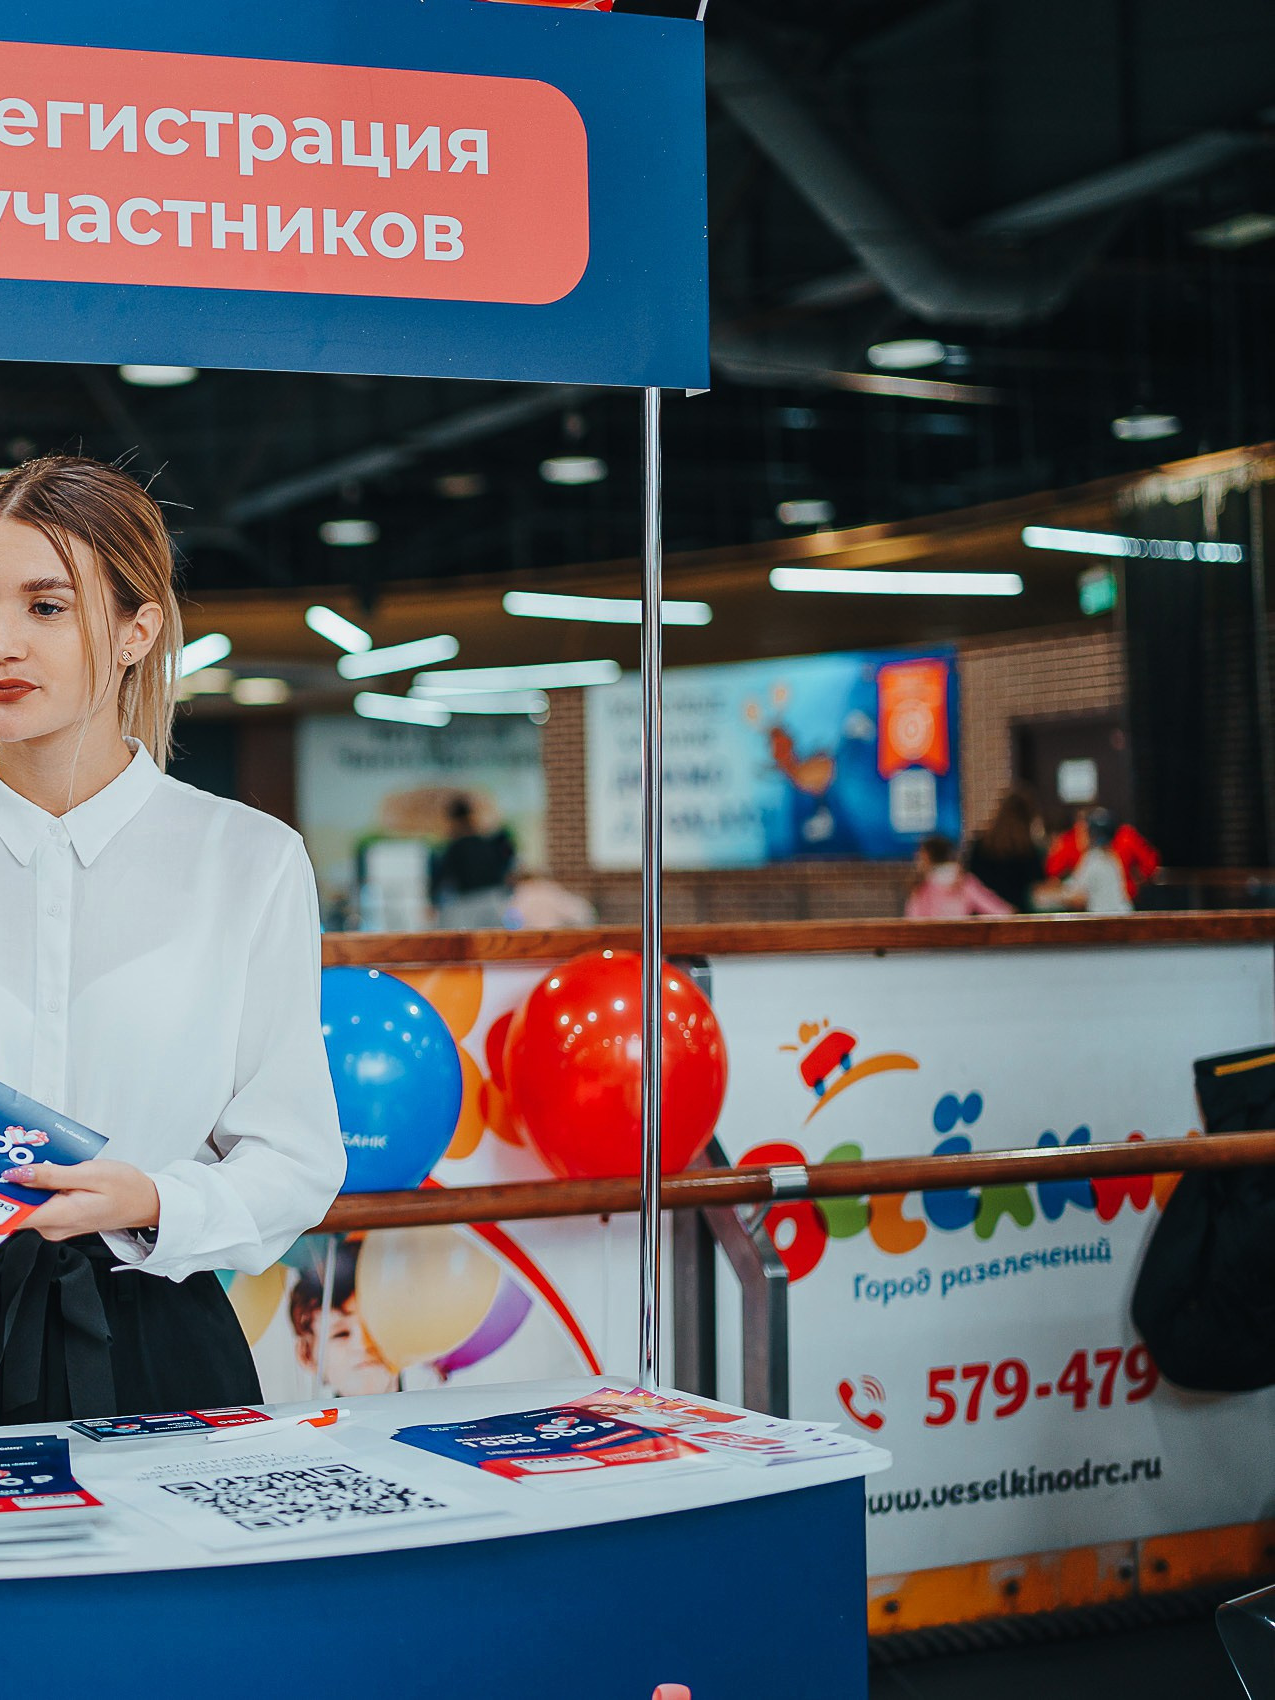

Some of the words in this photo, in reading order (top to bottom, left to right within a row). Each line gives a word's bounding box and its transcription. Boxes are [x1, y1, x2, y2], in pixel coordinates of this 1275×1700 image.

[853, 1266, 931, 1306] Город
[940, 1237, 1114, 1298] развлечений
[924, 1342, 1160, 1427] 579-479
[479, 1436, 537, 1447] 000
[540, 1425, 596, 1440] 000
